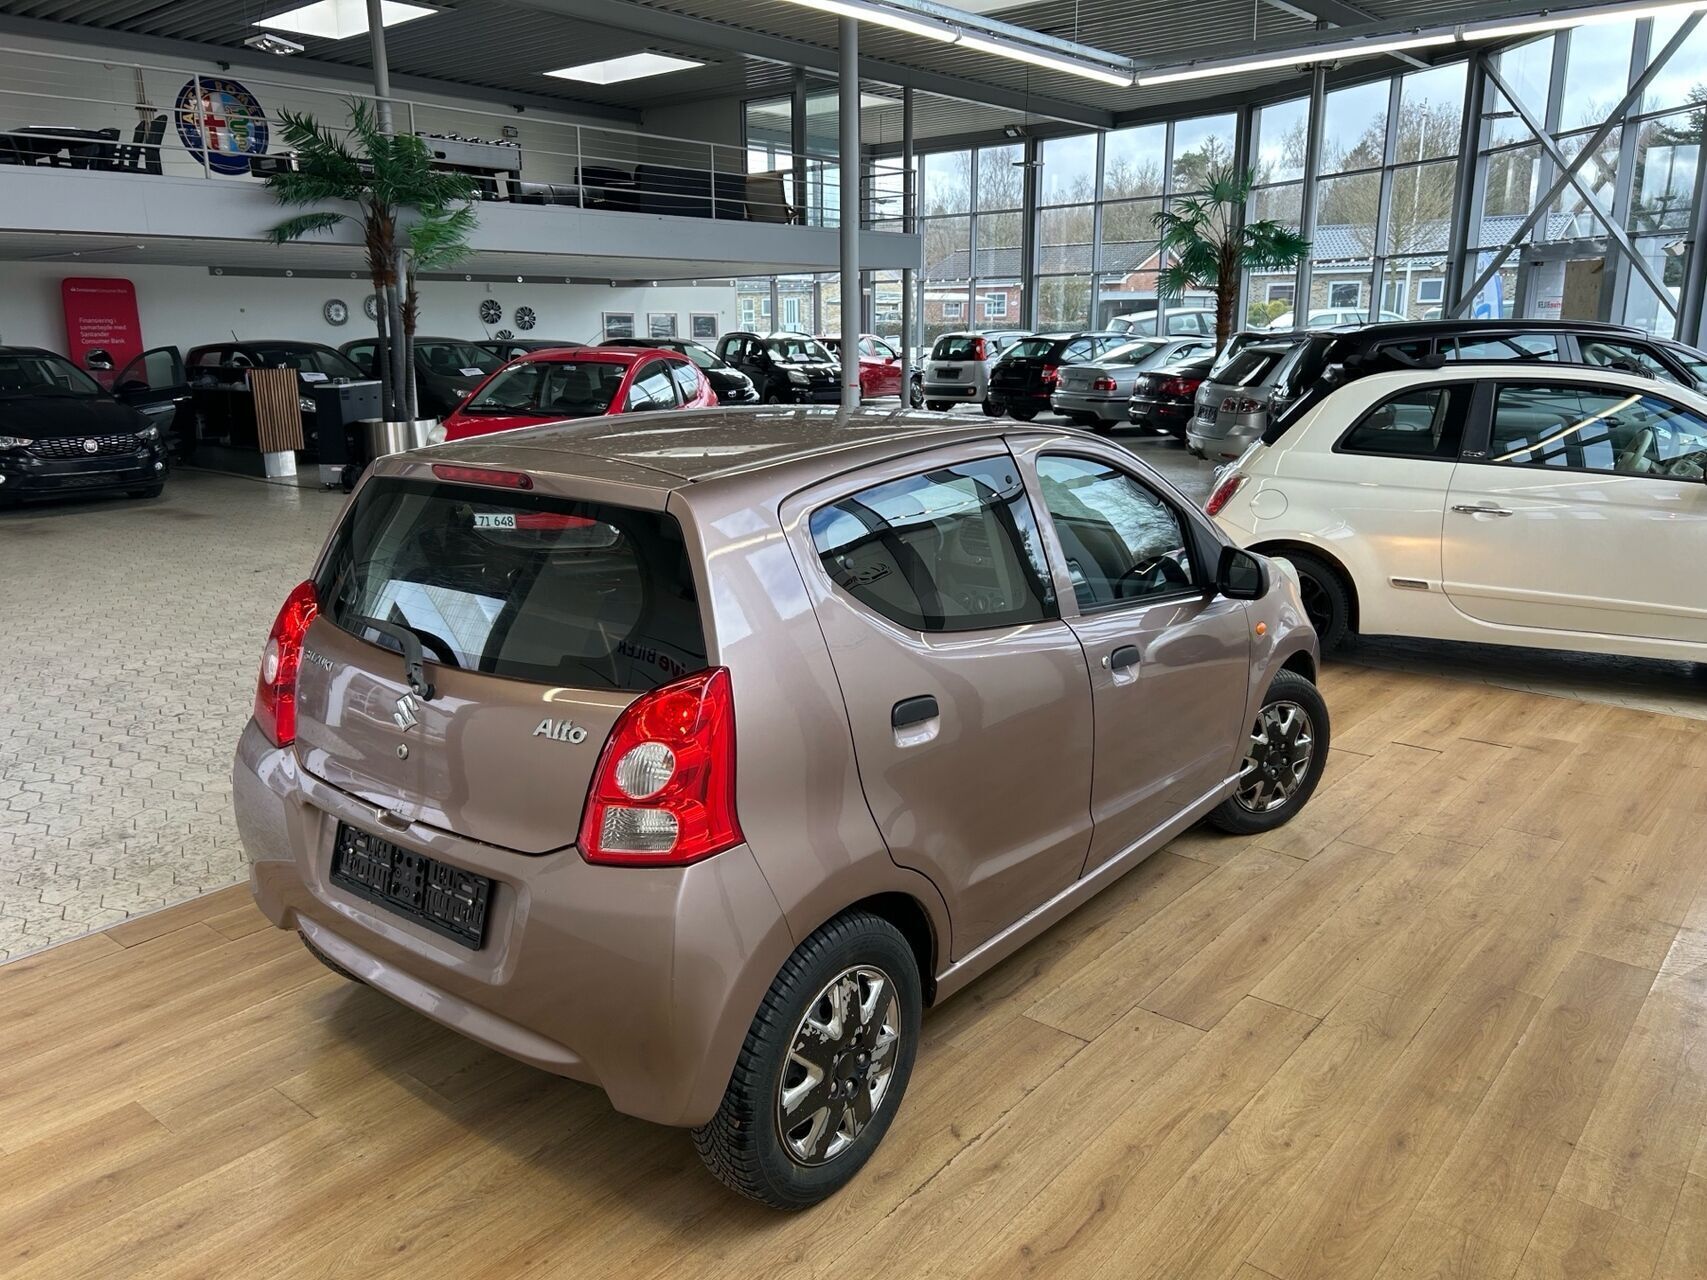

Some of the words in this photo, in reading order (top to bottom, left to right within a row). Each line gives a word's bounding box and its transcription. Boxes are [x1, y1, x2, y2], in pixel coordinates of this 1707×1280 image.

[478, 516, 490, 526] 71
[494, 516, 514, 527] 648
[533, 718, 588, 744] Alto
